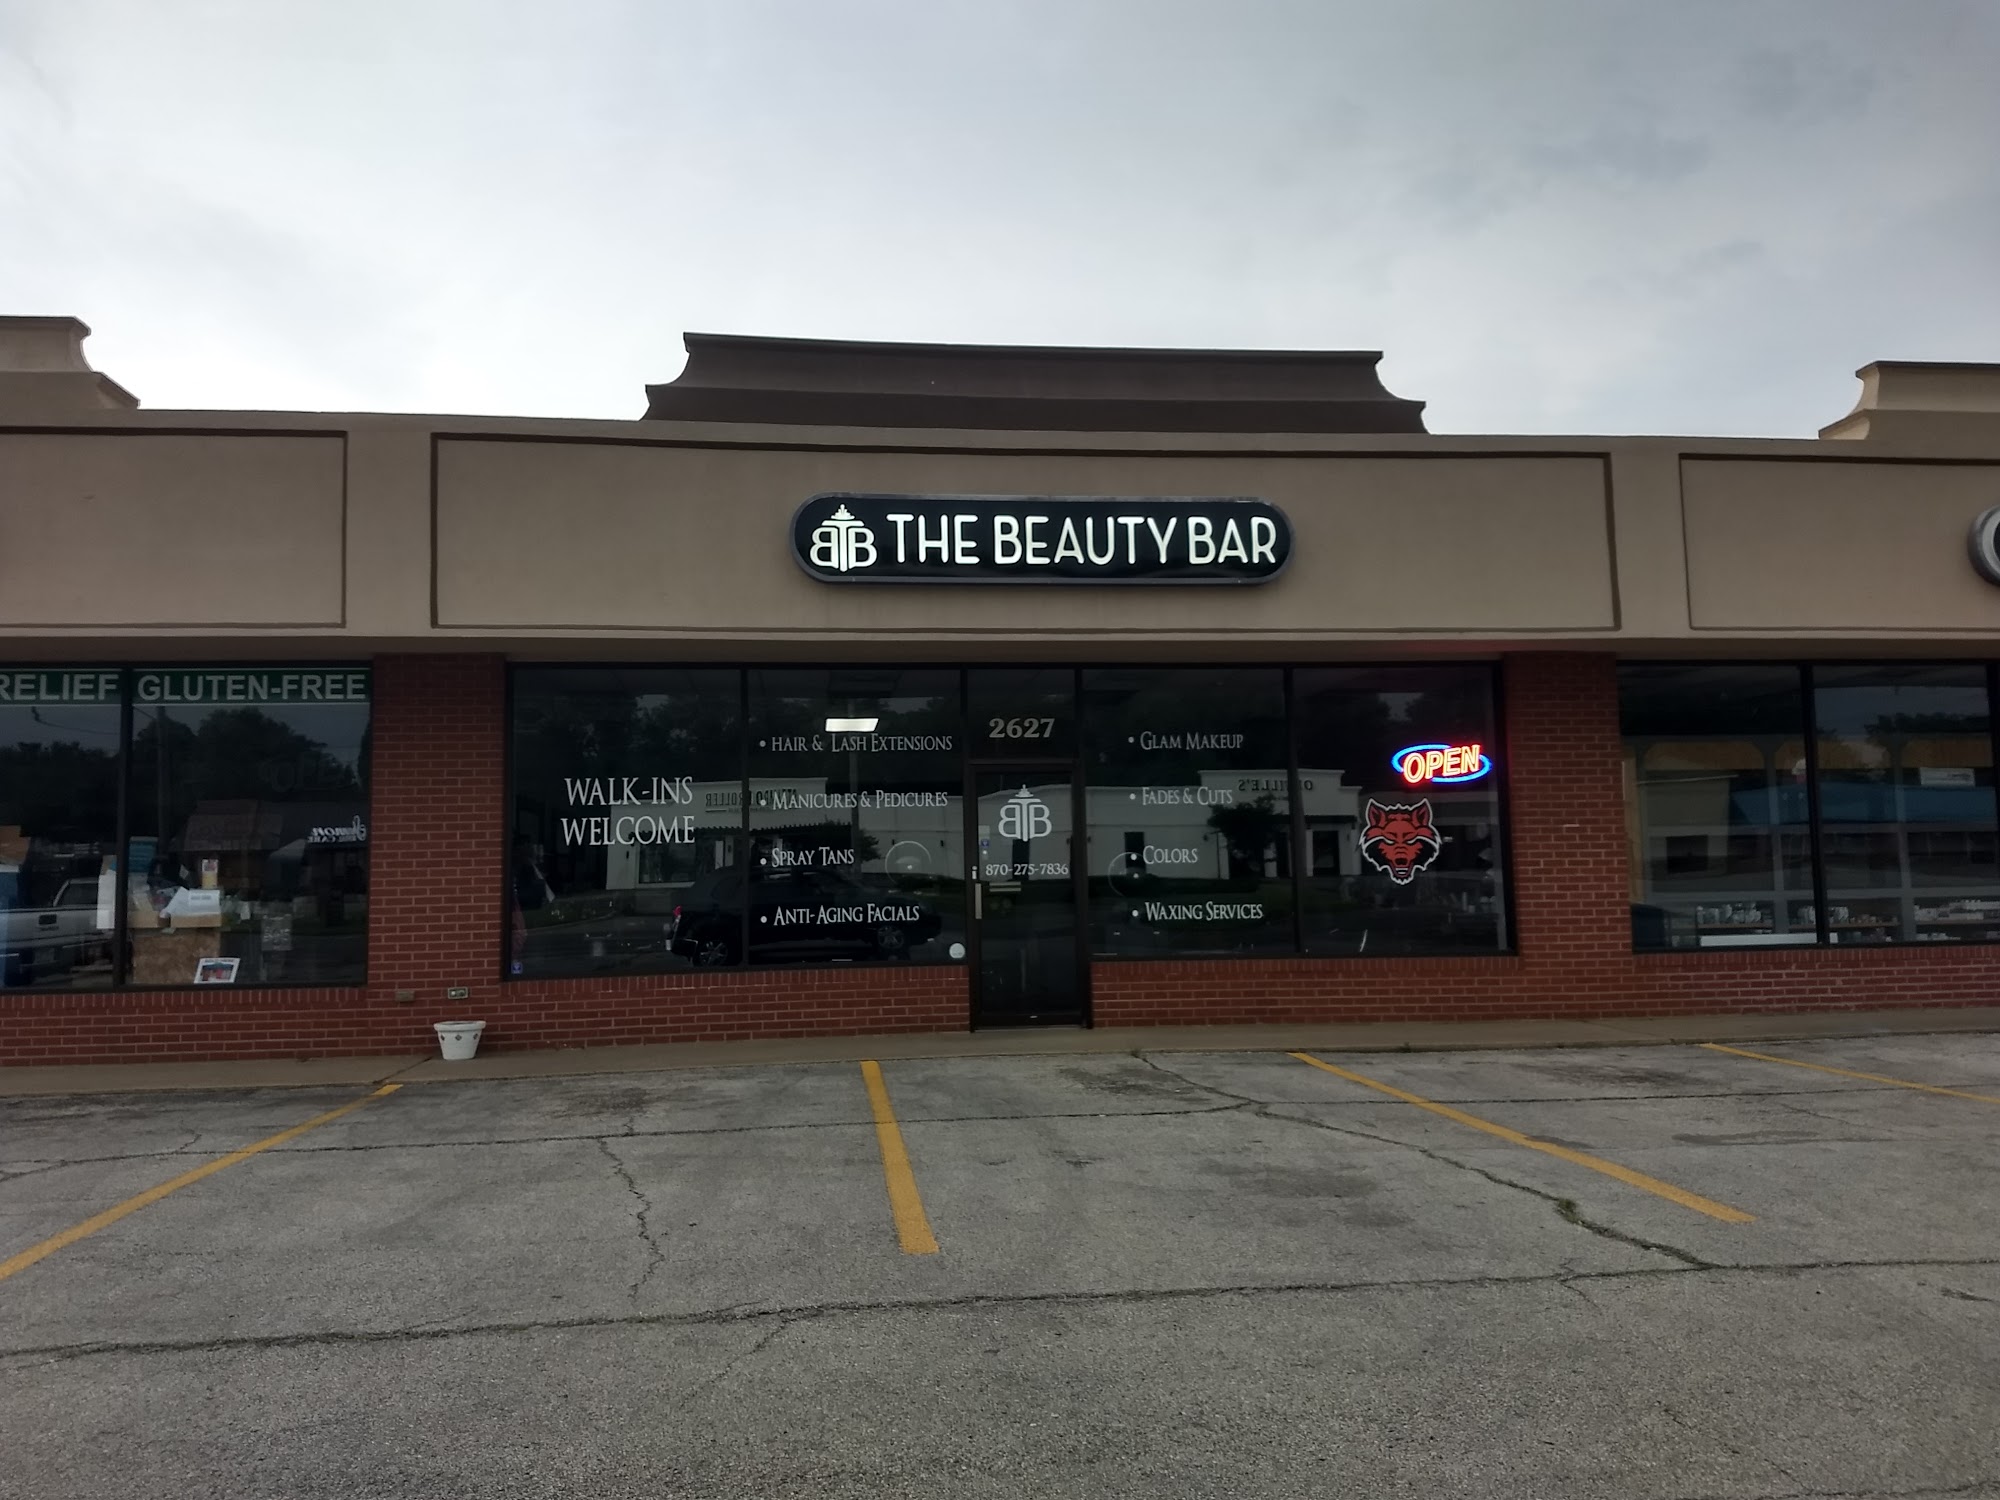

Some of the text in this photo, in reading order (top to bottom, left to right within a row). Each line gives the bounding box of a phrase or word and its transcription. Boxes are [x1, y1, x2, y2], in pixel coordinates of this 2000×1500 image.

[886, 513, 1277, 565] THE BEAUTY BAR
[138, 674, 366, 701] GLUTEN-FREE
[989, 717, 1055, 739] 2627
[772, 736, 808, 752] HAIR
[811, 735, 824, 751] &
[1403, 744, 1481, 784] OPEN
[564, 776, 694, 806] WALK-INS
[859, 790, 872, 808] &
[1182, 787, 1194, 804] &
[560, 815, 695, 846] WELCOME
[985, 862, 1069, 876] 870-275-7836
